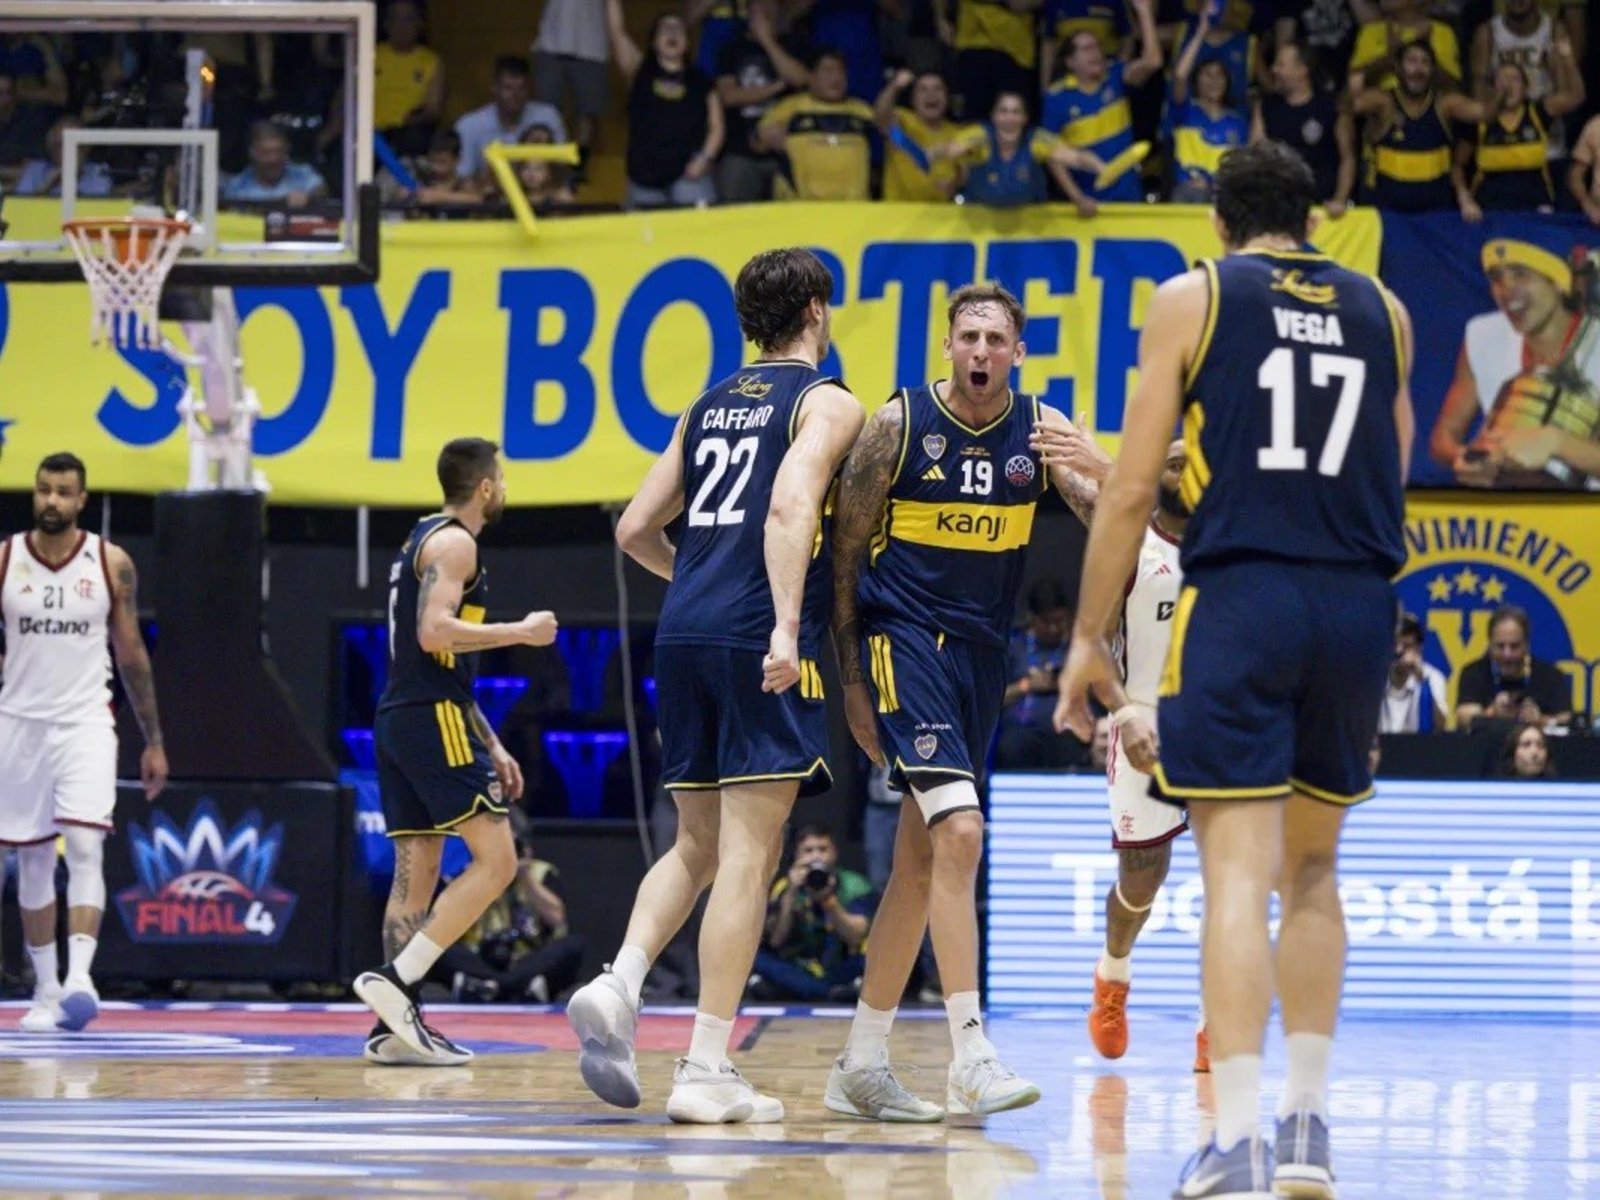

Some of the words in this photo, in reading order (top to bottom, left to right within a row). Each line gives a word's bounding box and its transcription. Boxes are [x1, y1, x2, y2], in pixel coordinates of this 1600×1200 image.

[1272, 306, 1344, 347] VEGA
[702, 404, 774, 430] CAFFARO
[1257, 348, 1366, 477] 17
[688, 436, 759, 527] 22
[960, 459, 993, 496] 19
[43, 585, 64, 609] 21
[19, 616, 90, 636] Betano
[1338, 857, 1540, 941] está
